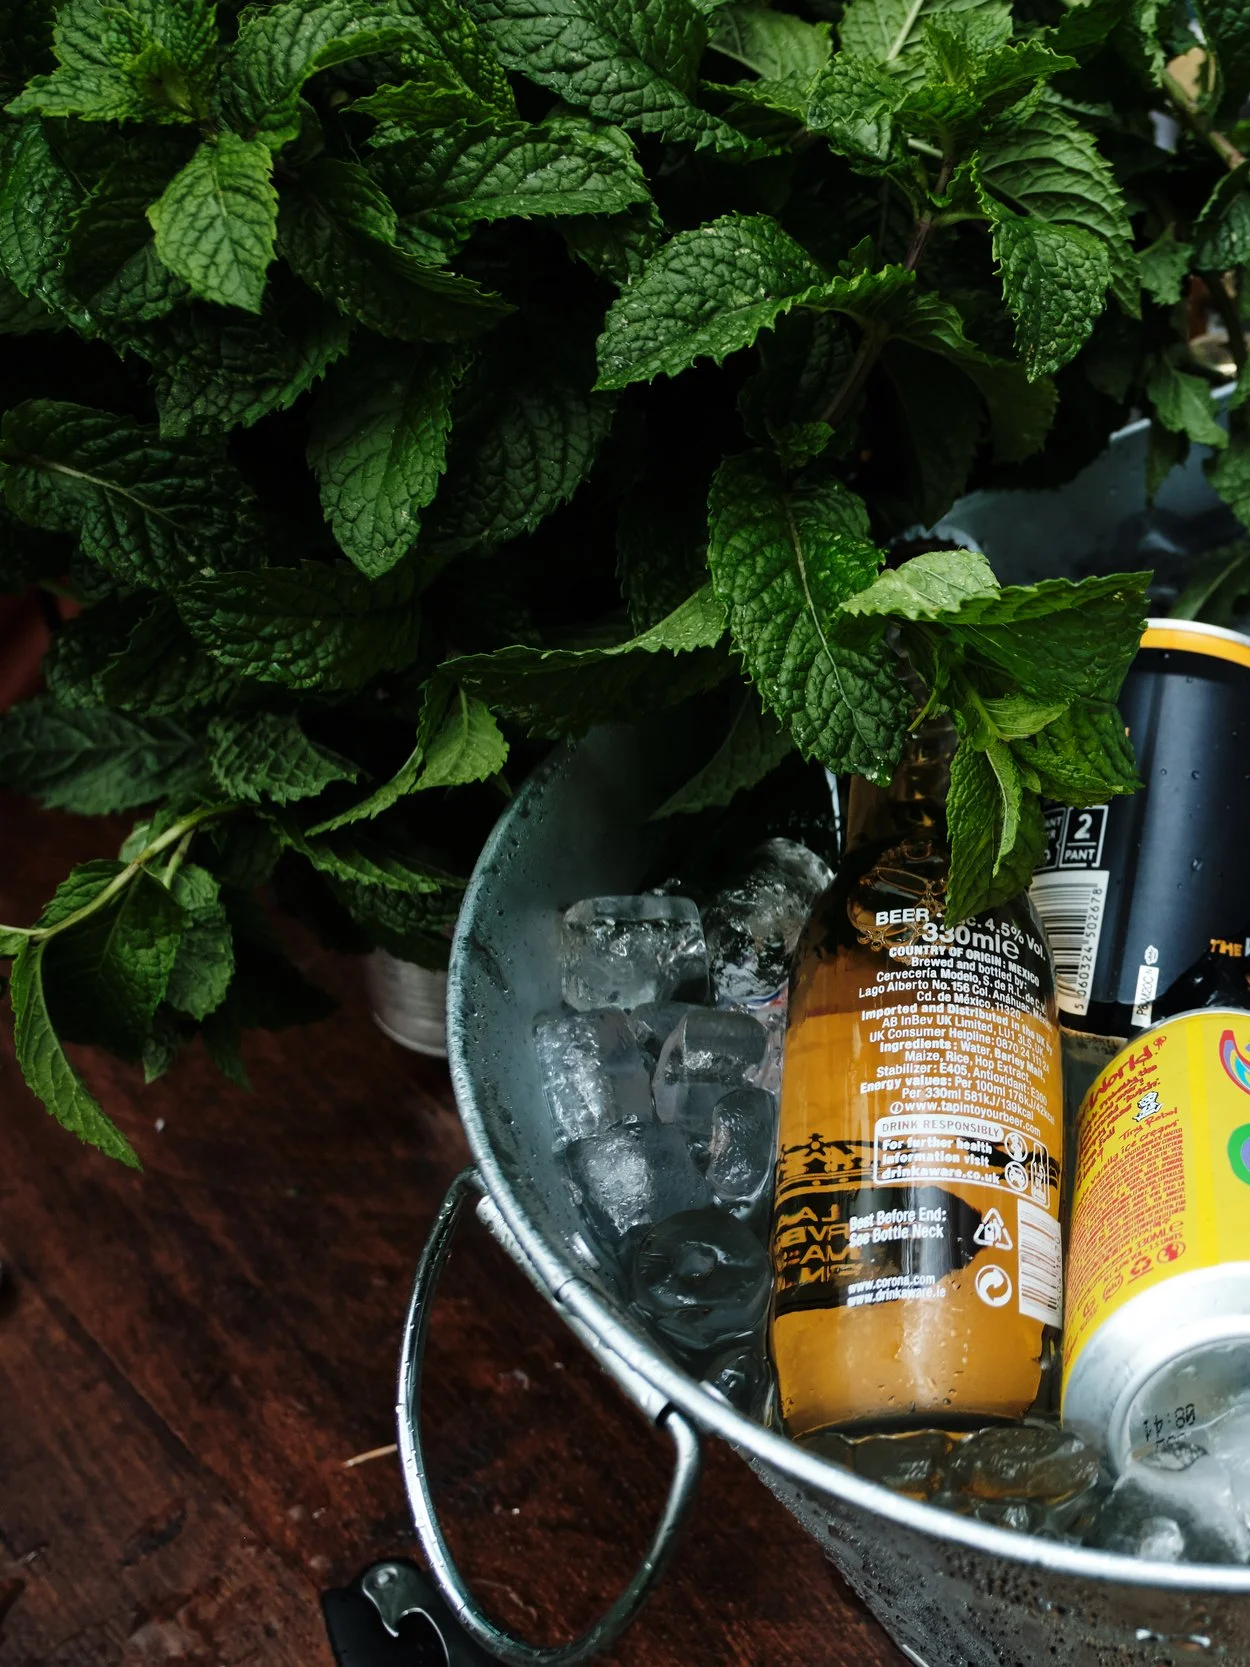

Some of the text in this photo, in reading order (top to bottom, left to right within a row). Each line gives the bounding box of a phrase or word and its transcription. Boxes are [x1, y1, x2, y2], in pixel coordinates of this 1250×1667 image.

[1074, 813, 1092, 840] 2
[1064, 849, 1096, 861] PANT
[1085, 888, 1103, 938] 502678
[876, 908, 1046, 961] BEER 4.5% Vol.
[1210, 938, 1243, 957] THE
[889, 945, 947, 957] COUNTRY
[948, 946, 963, 957] OF
[1008, 961, 1039, 987] MEXICO
[912, 957, 1027, 989] Brewed and bottled by:
[859, 979, 1032, 1016] Lago Alberto No. 156 Col. Anáhuac,
[876, 968, 937, 982] Cervecería
[941, 969, 982, 985] Modelo,
[983, 975, 993, 987] S.
[994, 980, 1006, 991] de
[1008, 983, 1025, 999] R.L.
[1026, 993, 1034, 1006] de
[861, 1002, 918, 1021] Imported
[921, 1002, 945, 1013] and
[947, 1003, 1009, 1026] Distributed
[1011, 1019, 1021, 1031] in
[1022, 1023, 1036, 1039] the
[917, 991, 1024, 1022] Cd. de México, 11320.
[882, 1016, 898, 1028] AB
[901, 1015, 934, 1026] InBev
[936, 1014, 952, 1026] UK
[954, 1015, 997, 1035] Limited,
[998, 1025, 1016, 1041] LU1
[870, 1030, 885, 1043] UK
[888, 1028, 947, 1039] Consumer
[949, 1027, 995, 1045] Helpline:
[996, 1036, 1019, 1053] 0870
[1021, 1048, 1031, 1060] 24
[905, 1050, 1032, 1086] Maize, Rice, Hop Extract,
[960, 1041, 993, 1058] Water,
[994, 1047, 1025, 1070] Barley
[1027, 1062, 1046, 1084] Malt,
[860, 1077, 902, 1094] Energy
[905, 1074, 952, 1087] values:
[954, 1076, 973, 1088] Per
[976, 1080, 1006, 1097] 100ml
[877, 1062, 1048, 1107] Stabilizer: E405, Antioxidant: E300
[902, 1087, 1034, 1121] Per 330ml 581kJ/139kcal
[905, 1101, 1041, 1138] www.tapintoyourbeer.com
[882, 1119, 1000, 1137] DRINK RESPONSIBLY
[1119, 1107, 1178, 1141] Tiny Rebel
[882, 1136, 993, 1155] For further health
[882, 1150, 990, 1168] information visit
[881, 1165, 1001, 1185] drinkaware.co.uk
[849, 1207, 947, 1231] Best Before End:
[849, 1224, 944, 1248] See Bottle Neck
[847, 1286, 946, 1307] www.drinkaware.ie
[848, 1275, 936, 1294] www.corona.com
